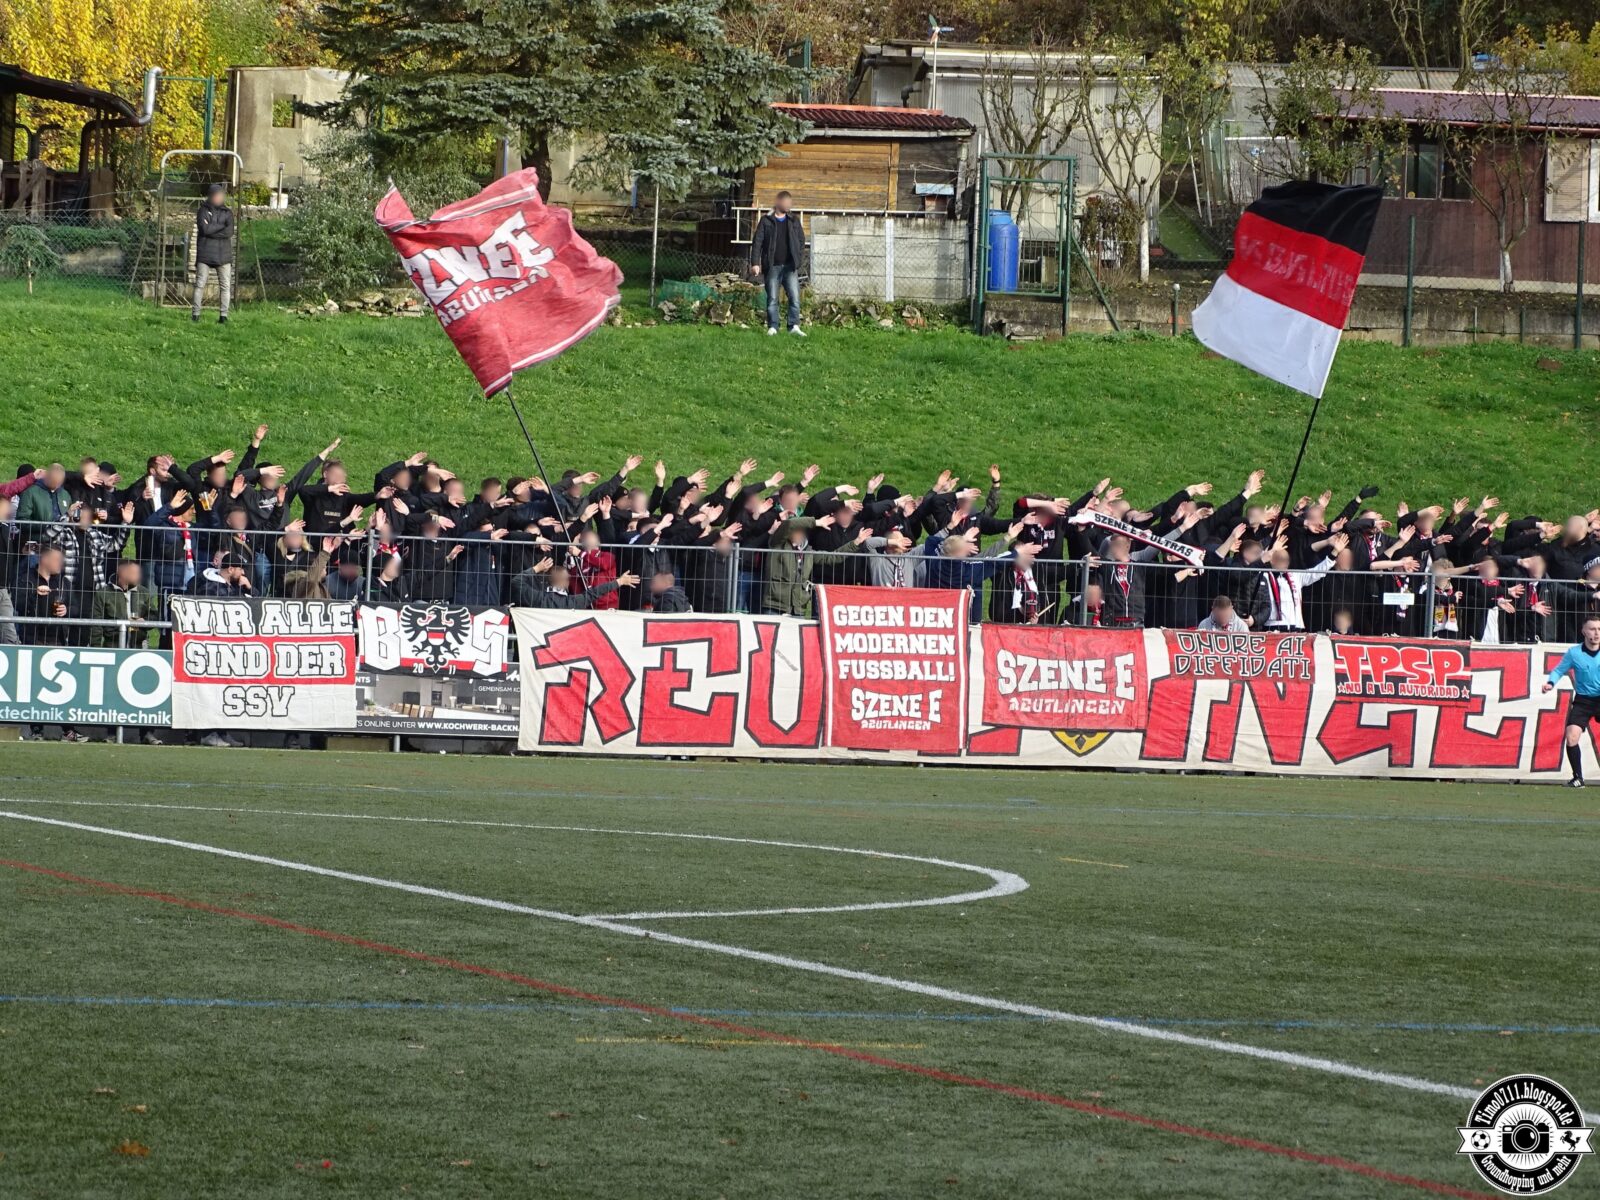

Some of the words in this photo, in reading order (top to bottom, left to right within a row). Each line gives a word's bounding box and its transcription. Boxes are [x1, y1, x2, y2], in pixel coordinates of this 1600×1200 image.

[1094, 513, 1129, 531] SZENE
[1149, 535, 1194, 557] ULTRAS
[173, 599, 255, 635] WIR
[260, 601, 354, 636] ALLE
[832, 605, 905, 626] GEGEN
[909, 606, 955, 628] DEN
[834, 633, 956, 655] MODERNEN
[1276, 635, 1306, 658] AI
[184, 641, 269, 677] SIND
[273, 643, 346, 677] DER
[838, 659, 956, 682] FUSSBALL!
[1174, 654, 1312, 679] DIFFIDATI
[1335, 643, 1464, 687] TPSP
[996, 648, 1108, 696] SZENE
[1115, 652, 1136, 701] E
[223, 686, 295, 717] SSV
[1345, 682, 1362, 694] NO
[1366, 682, 1376, 695] A
[1380, 682, 1396, 695] LA
[1399, 683, 1460, 699] AUTORIDAD
[68, 707, 172, 725] Strahltechnik
[851, 687, 923, 721] SZENE
[928, 689, 943, 723] E
[1008, 697, 1126, 715] REUTLINGEN
[364, 720, 391, 728] ONLINE
[392, 721, 416, 729] UNTER
[417, 722, 519, 732] WWW.KOCHWERK-BACKN
[861, 720, 931, 730] REUTLINGEN
